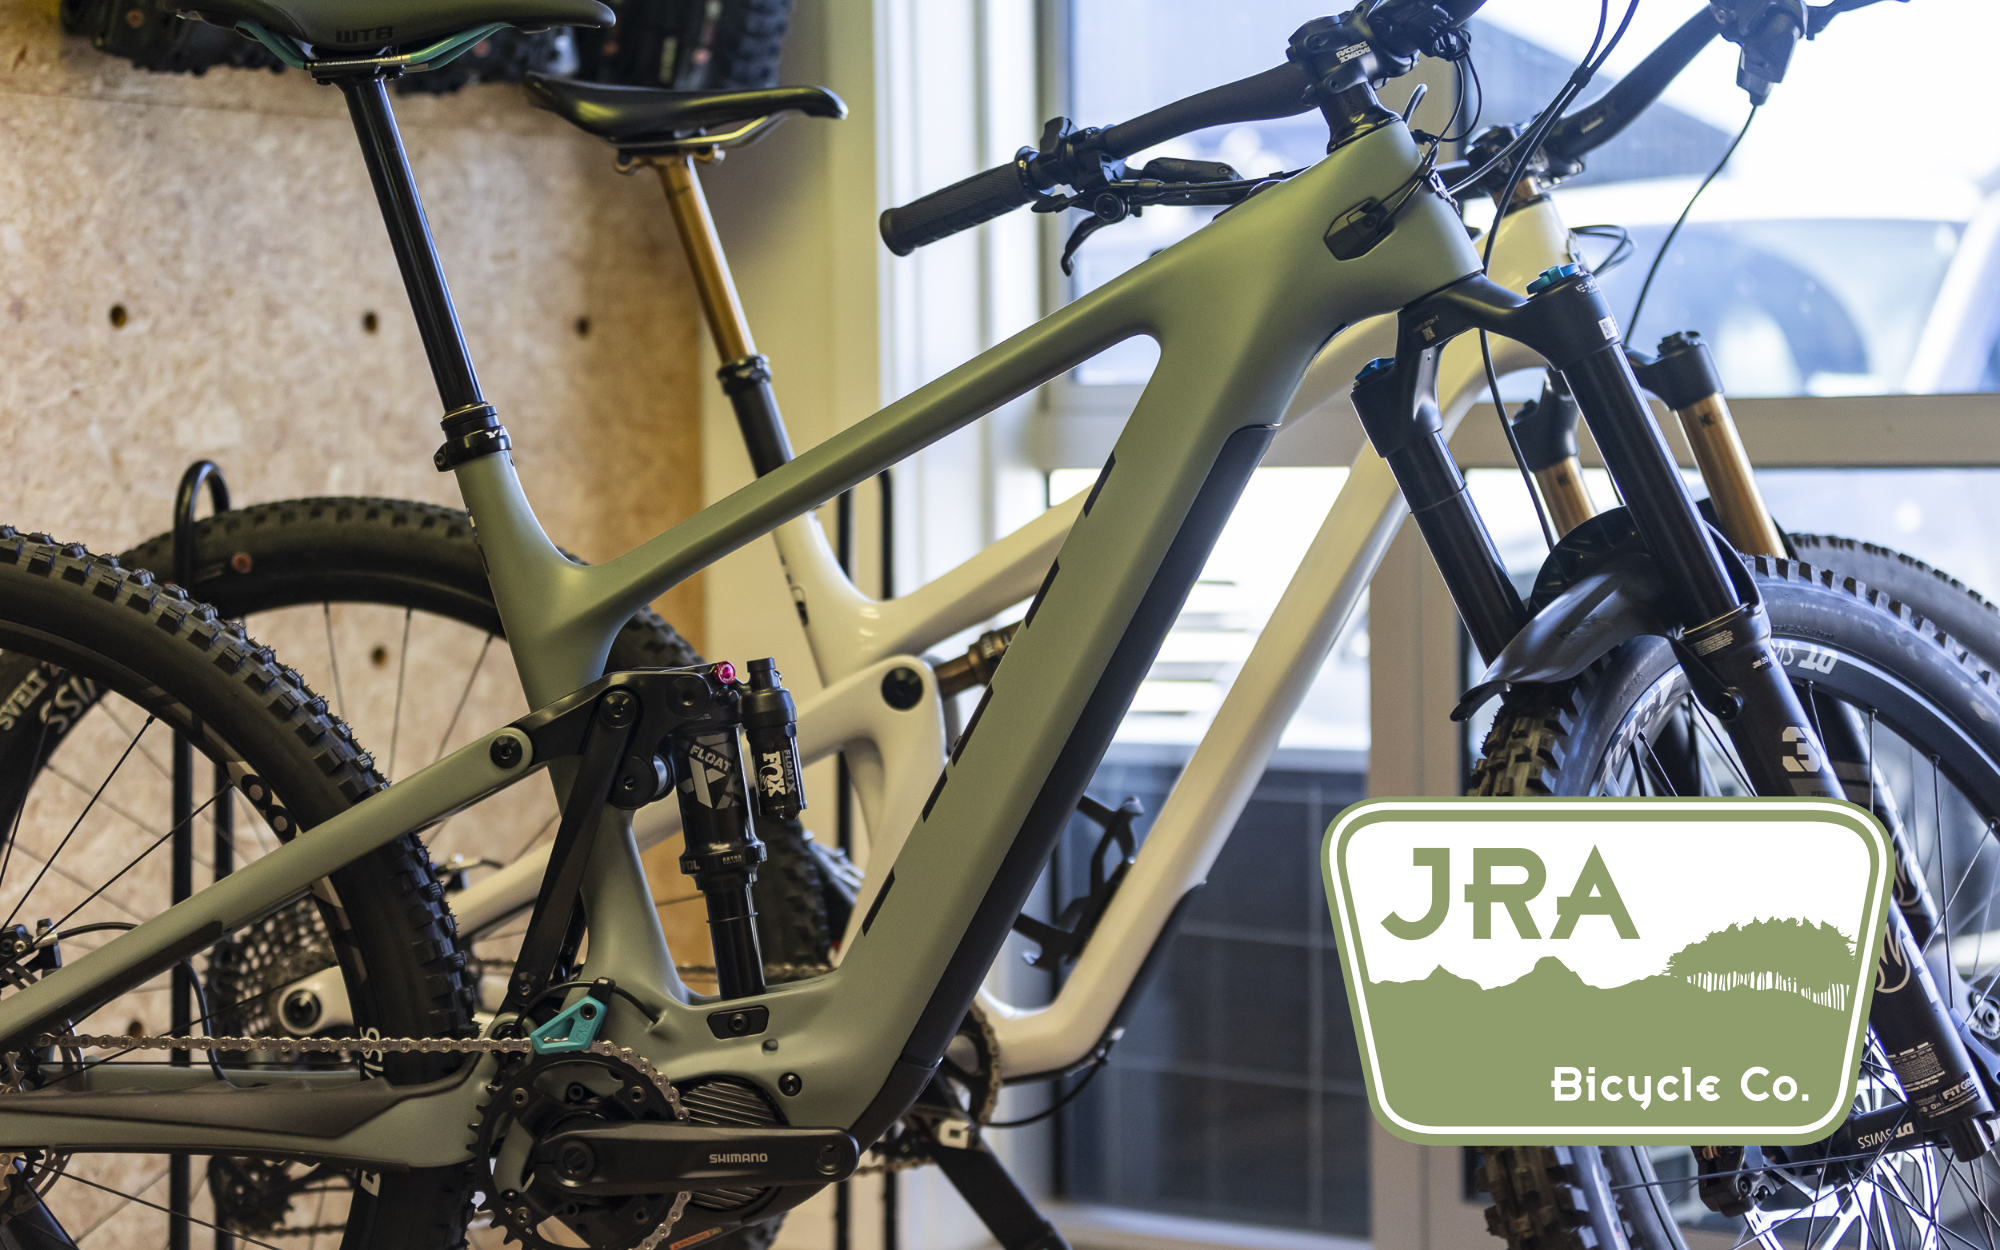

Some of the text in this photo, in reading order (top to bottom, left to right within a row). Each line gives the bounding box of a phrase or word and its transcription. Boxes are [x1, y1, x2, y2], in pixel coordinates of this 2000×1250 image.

[335, 25, 393, 43] WTB
[689, 744, 732, 772] FLOAT
[759, 751, 787, 798] FOX
[1857, 1121, 1915, 1149] DT SWISS
[709, 1153, 768, 1164] SHIMANO
